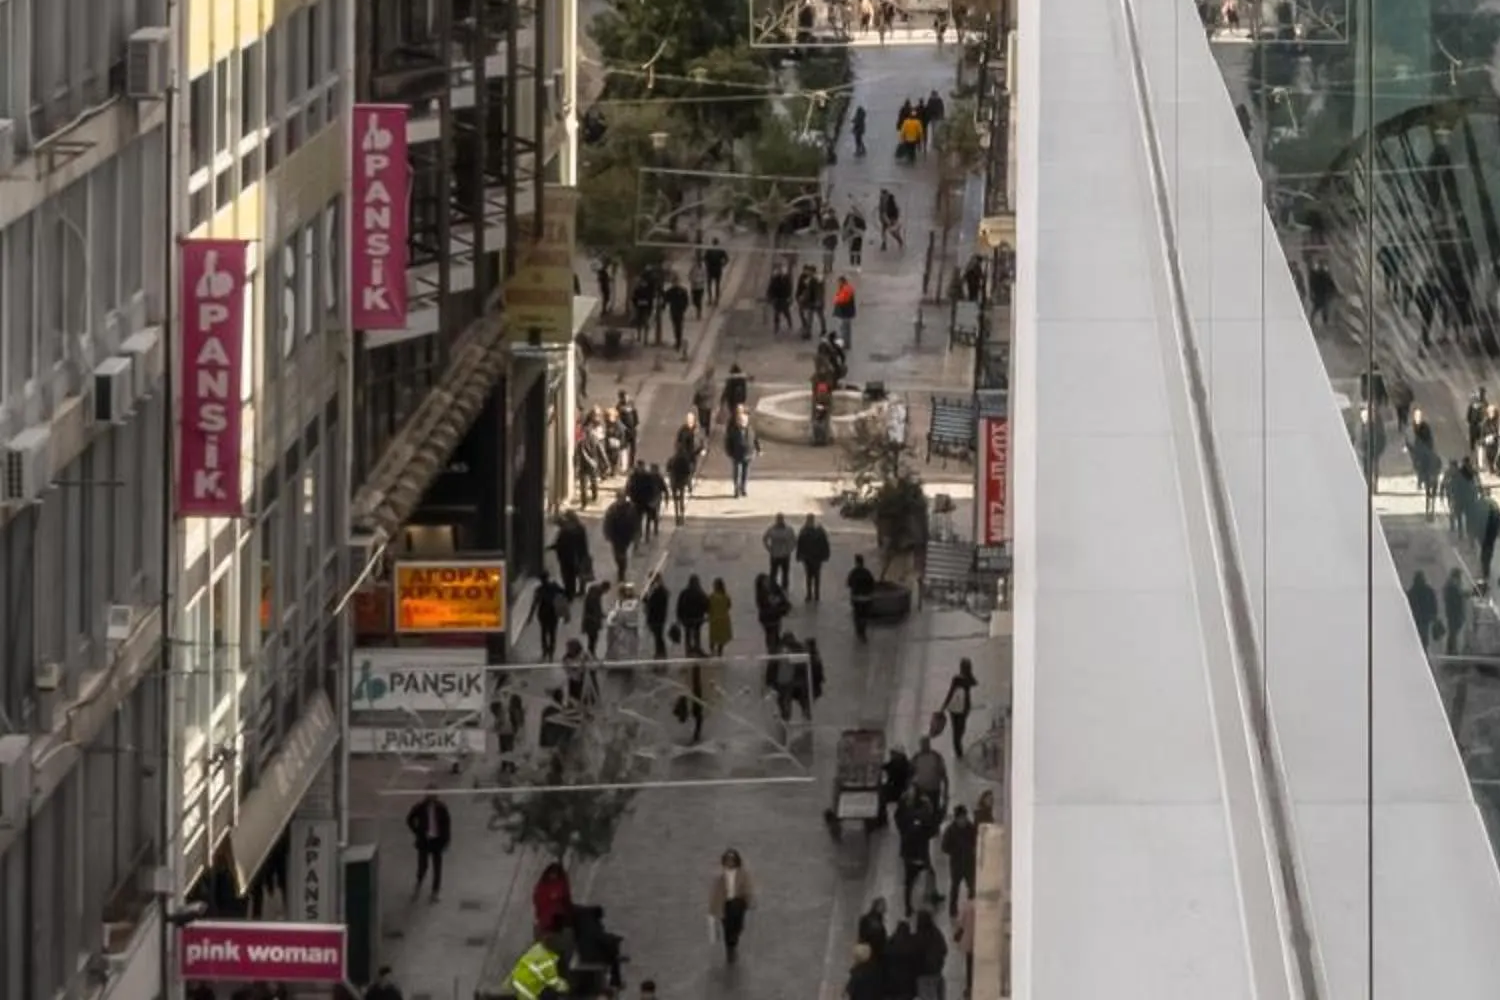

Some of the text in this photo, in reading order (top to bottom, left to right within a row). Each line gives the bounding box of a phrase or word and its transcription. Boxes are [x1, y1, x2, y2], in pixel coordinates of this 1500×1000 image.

[304, 850, 320, 921] PANS
[185, 937, 339, 966] pink woman
